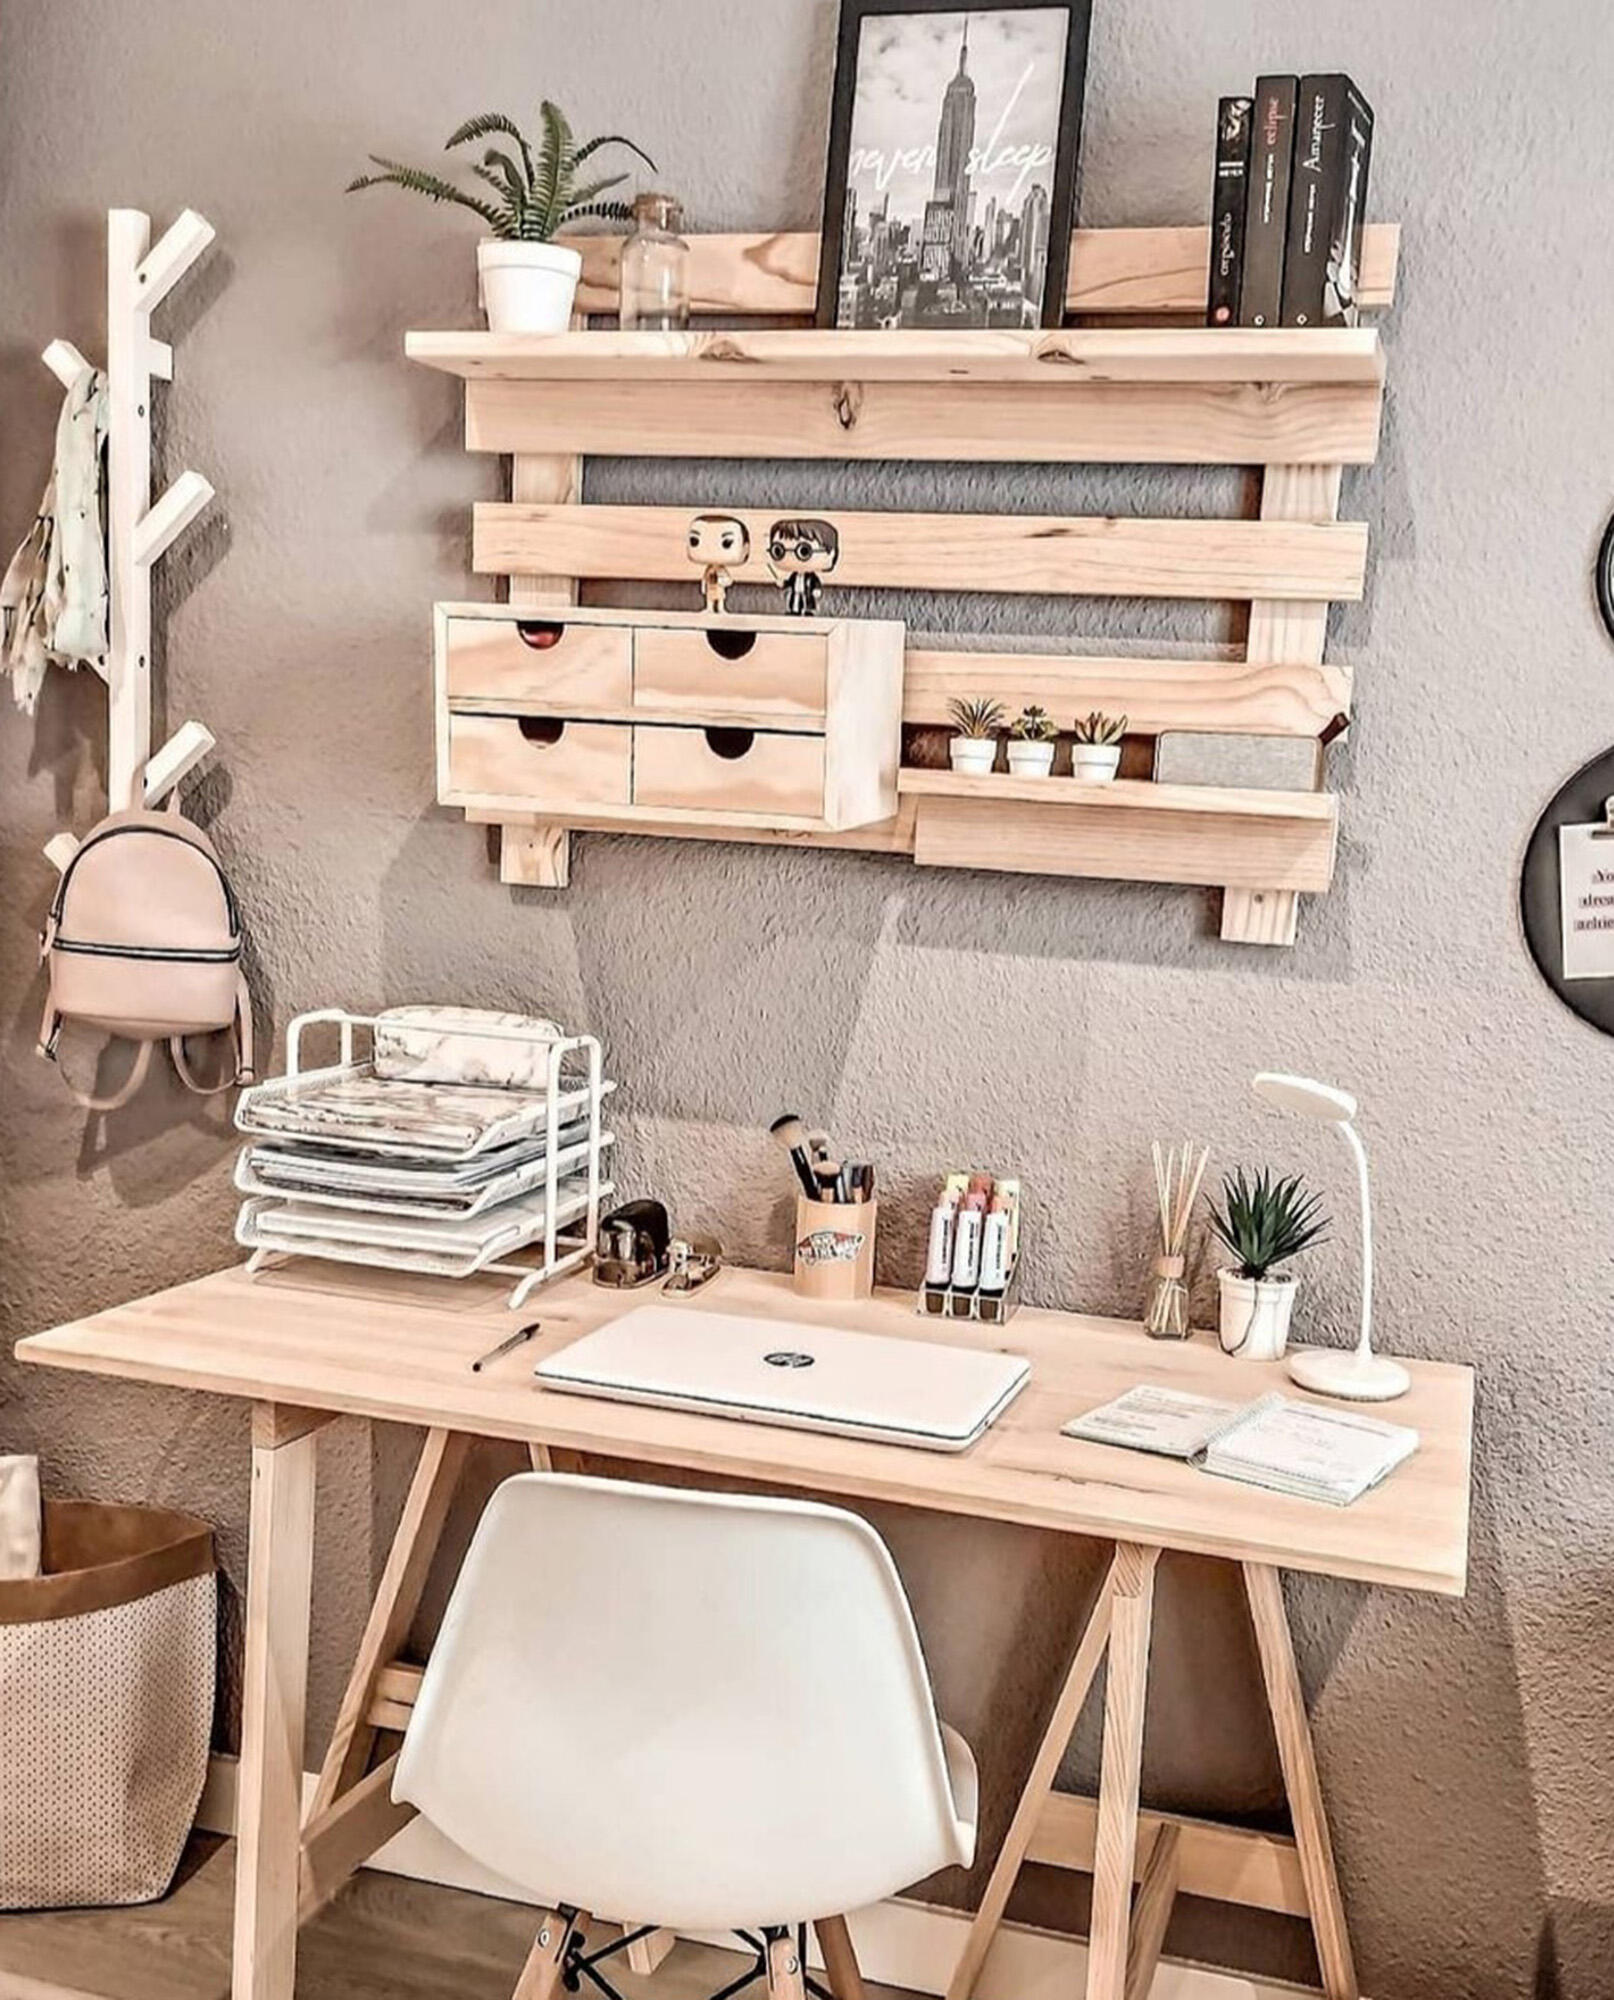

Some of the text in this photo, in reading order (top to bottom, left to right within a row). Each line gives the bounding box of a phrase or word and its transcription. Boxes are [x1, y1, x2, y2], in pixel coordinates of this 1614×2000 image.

[851, 62, 1052, 207] never sleep
[1265, 95, 1288, 145] eclipse
[1301, 94, 1337, 174] Amanecer
